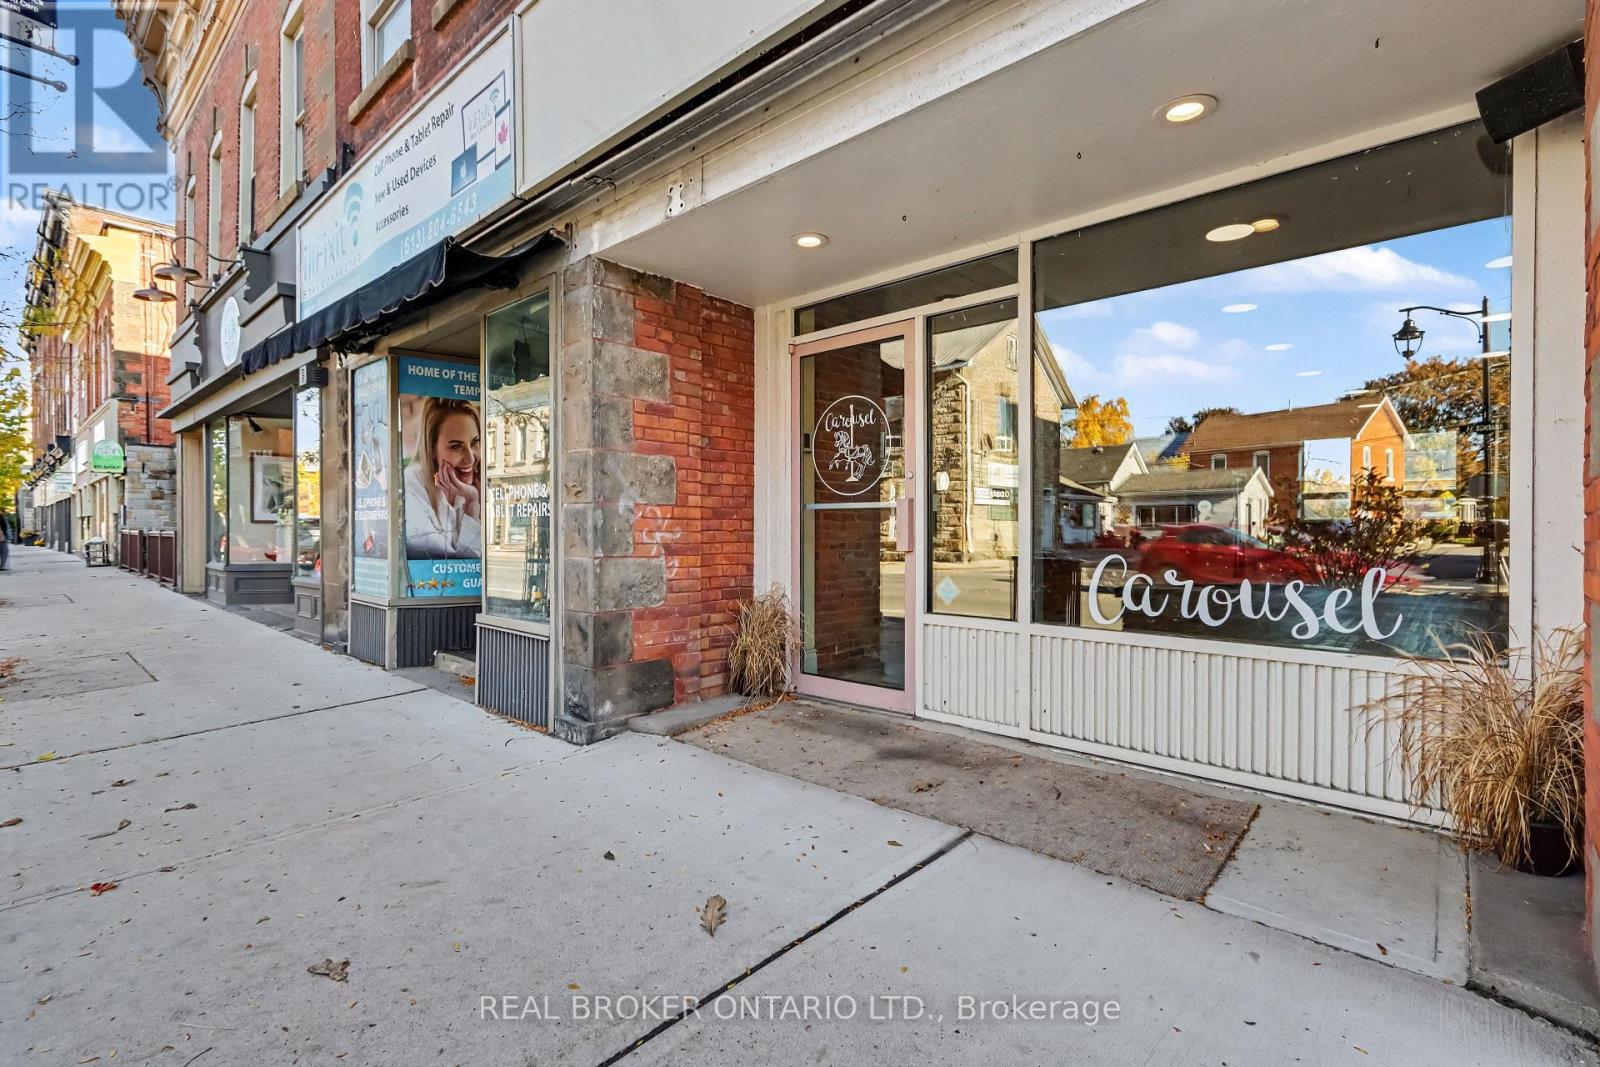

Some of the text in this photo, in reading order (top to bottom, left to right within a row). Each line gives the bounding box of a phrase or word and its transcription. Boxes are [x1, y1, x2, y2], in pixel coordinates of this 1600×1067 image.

[374, 159, 384, 177] Cell
[384, 146, 403, 168] Phone
[404, 138, 410, 153] &
[411, 122, 431, 149] Tablet
[431, 102, 455, 131] Repair
[374, 154, 437, 205] New & Used Devices
[375, 204, 409, 234] Accessories
[408, 365, 440, 378] HOME
[442, 369, 456, 380] OF
[457, 371, 478, 383] THE
[825, 408, 877, 432] Carousel
[541, 483, 549, 498] &
[1087, 553, 1403, 641] Carousel
